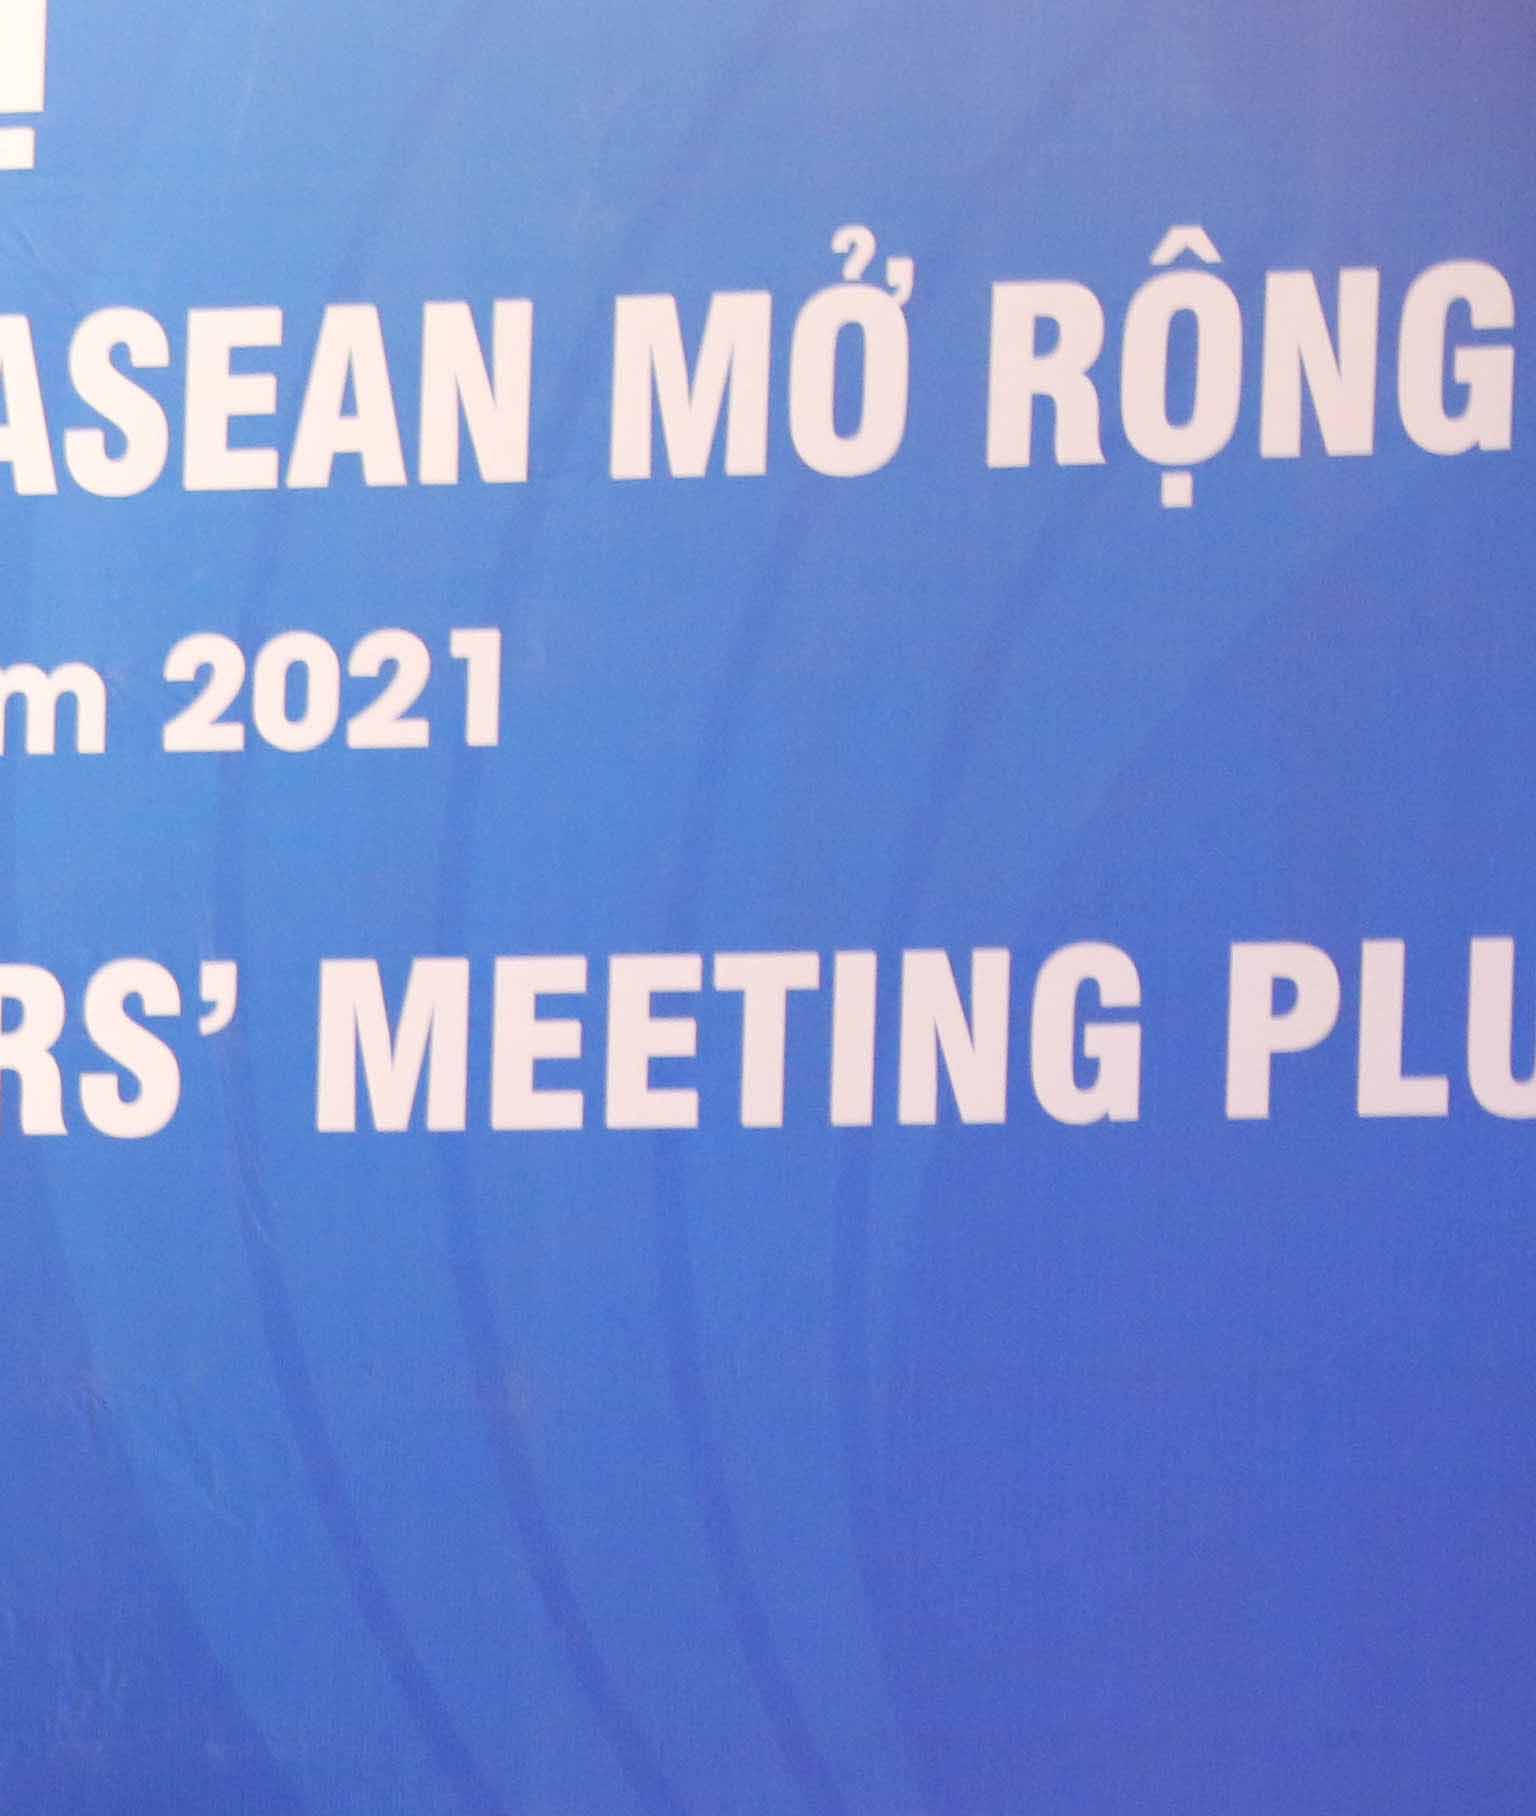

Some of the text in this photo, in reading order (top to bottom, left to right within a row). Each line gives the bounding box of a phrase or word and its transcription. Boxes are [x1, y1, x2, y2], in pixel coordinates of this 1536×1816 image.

[608, 238, 916, 482] MỞ
[985, 238, 1516, 508] RỘNG
[161, 626, 504, 754] 2021
[315, 941, 1143, 1134] MEETING
